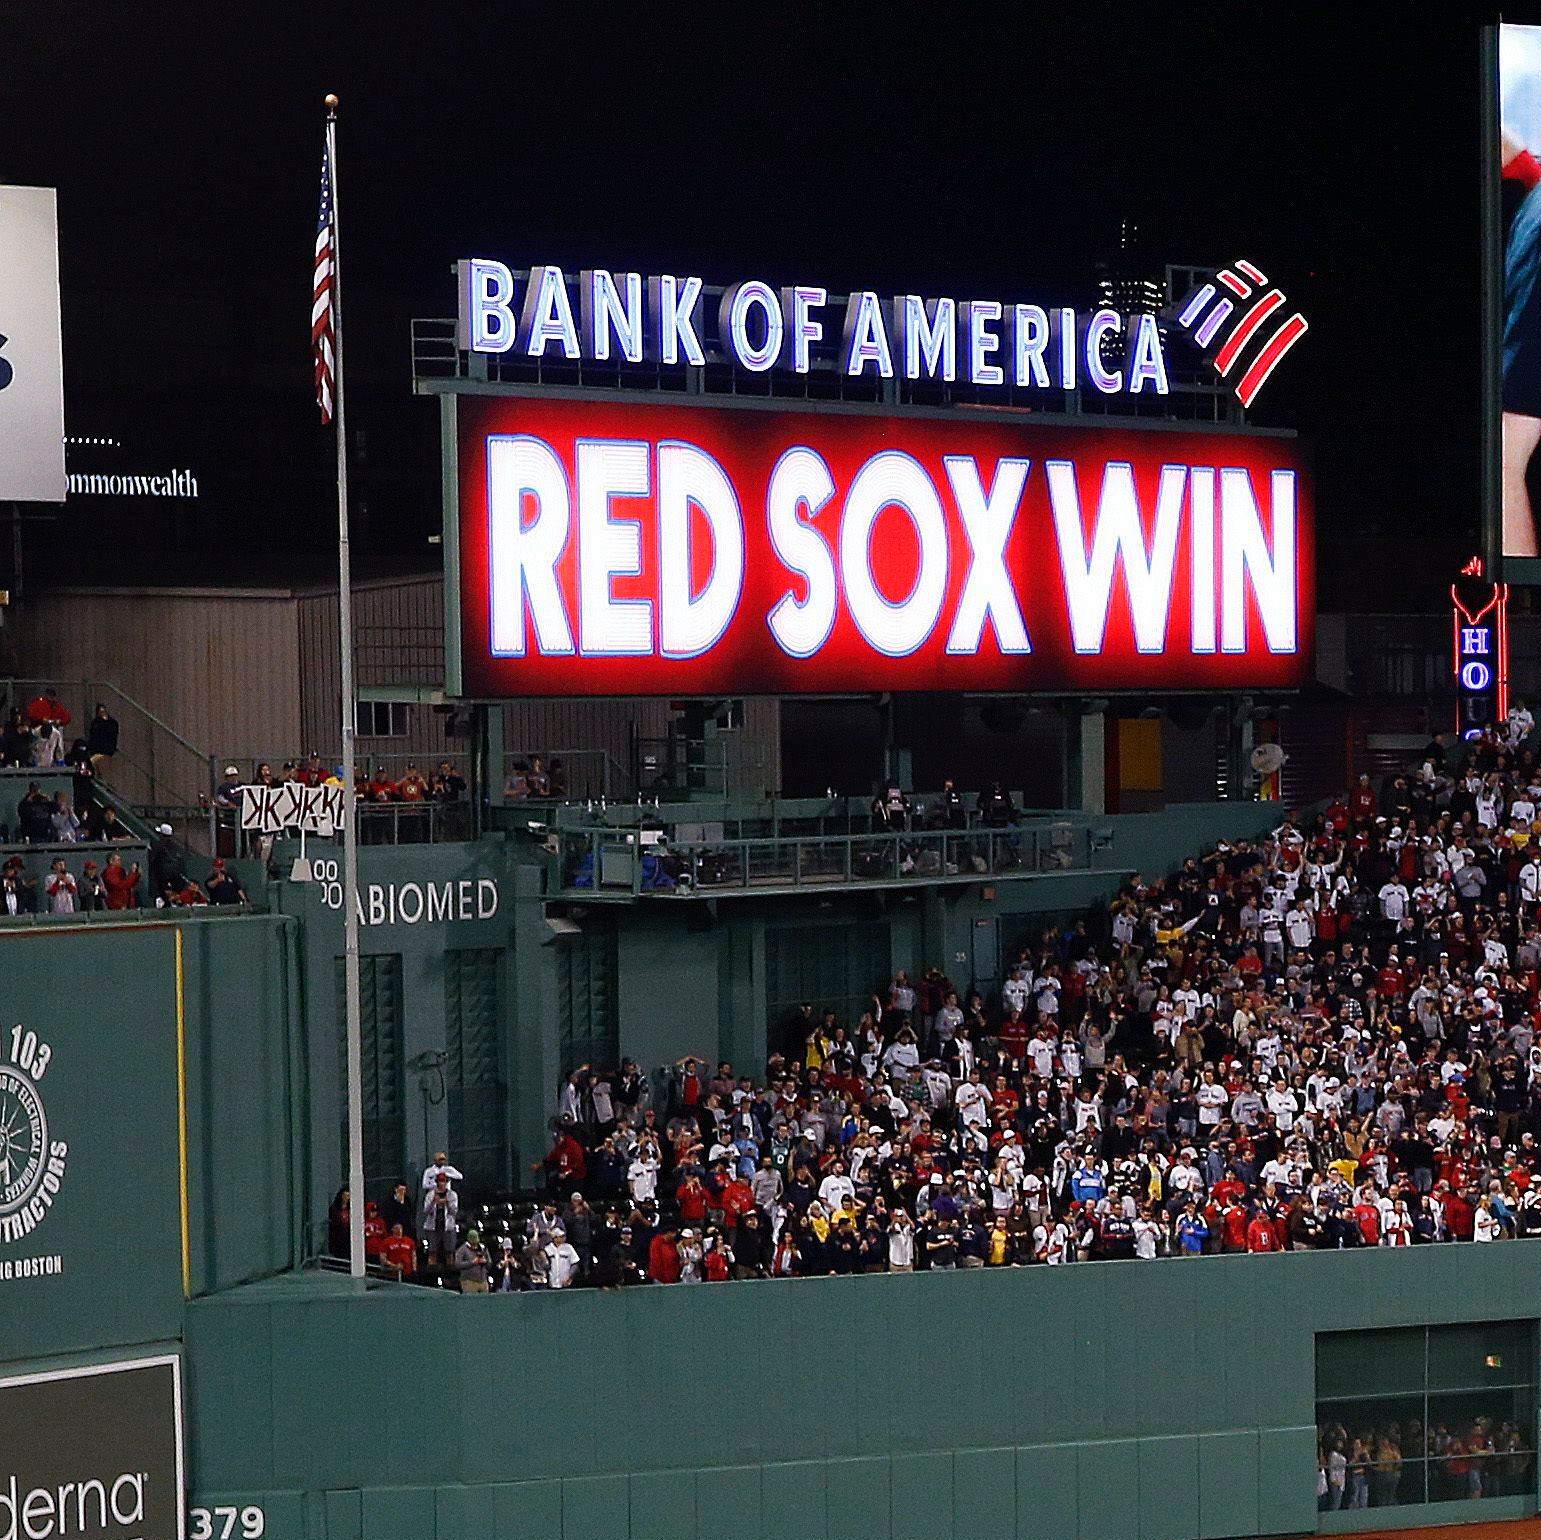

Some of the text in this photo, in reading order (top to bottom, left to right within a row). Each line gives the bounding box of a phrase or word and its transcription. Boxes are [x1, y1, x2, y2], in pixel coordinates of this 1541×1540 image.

[467, 258, 1172, 396] BANK OF AMERICA
[486, 434, 1298, 659] RED SOX WIN
[10, 1025, 52, 1081] 103
[15, 1255, 63, 1278] BOSTON
[189, 1505, 265, 1540] 379
